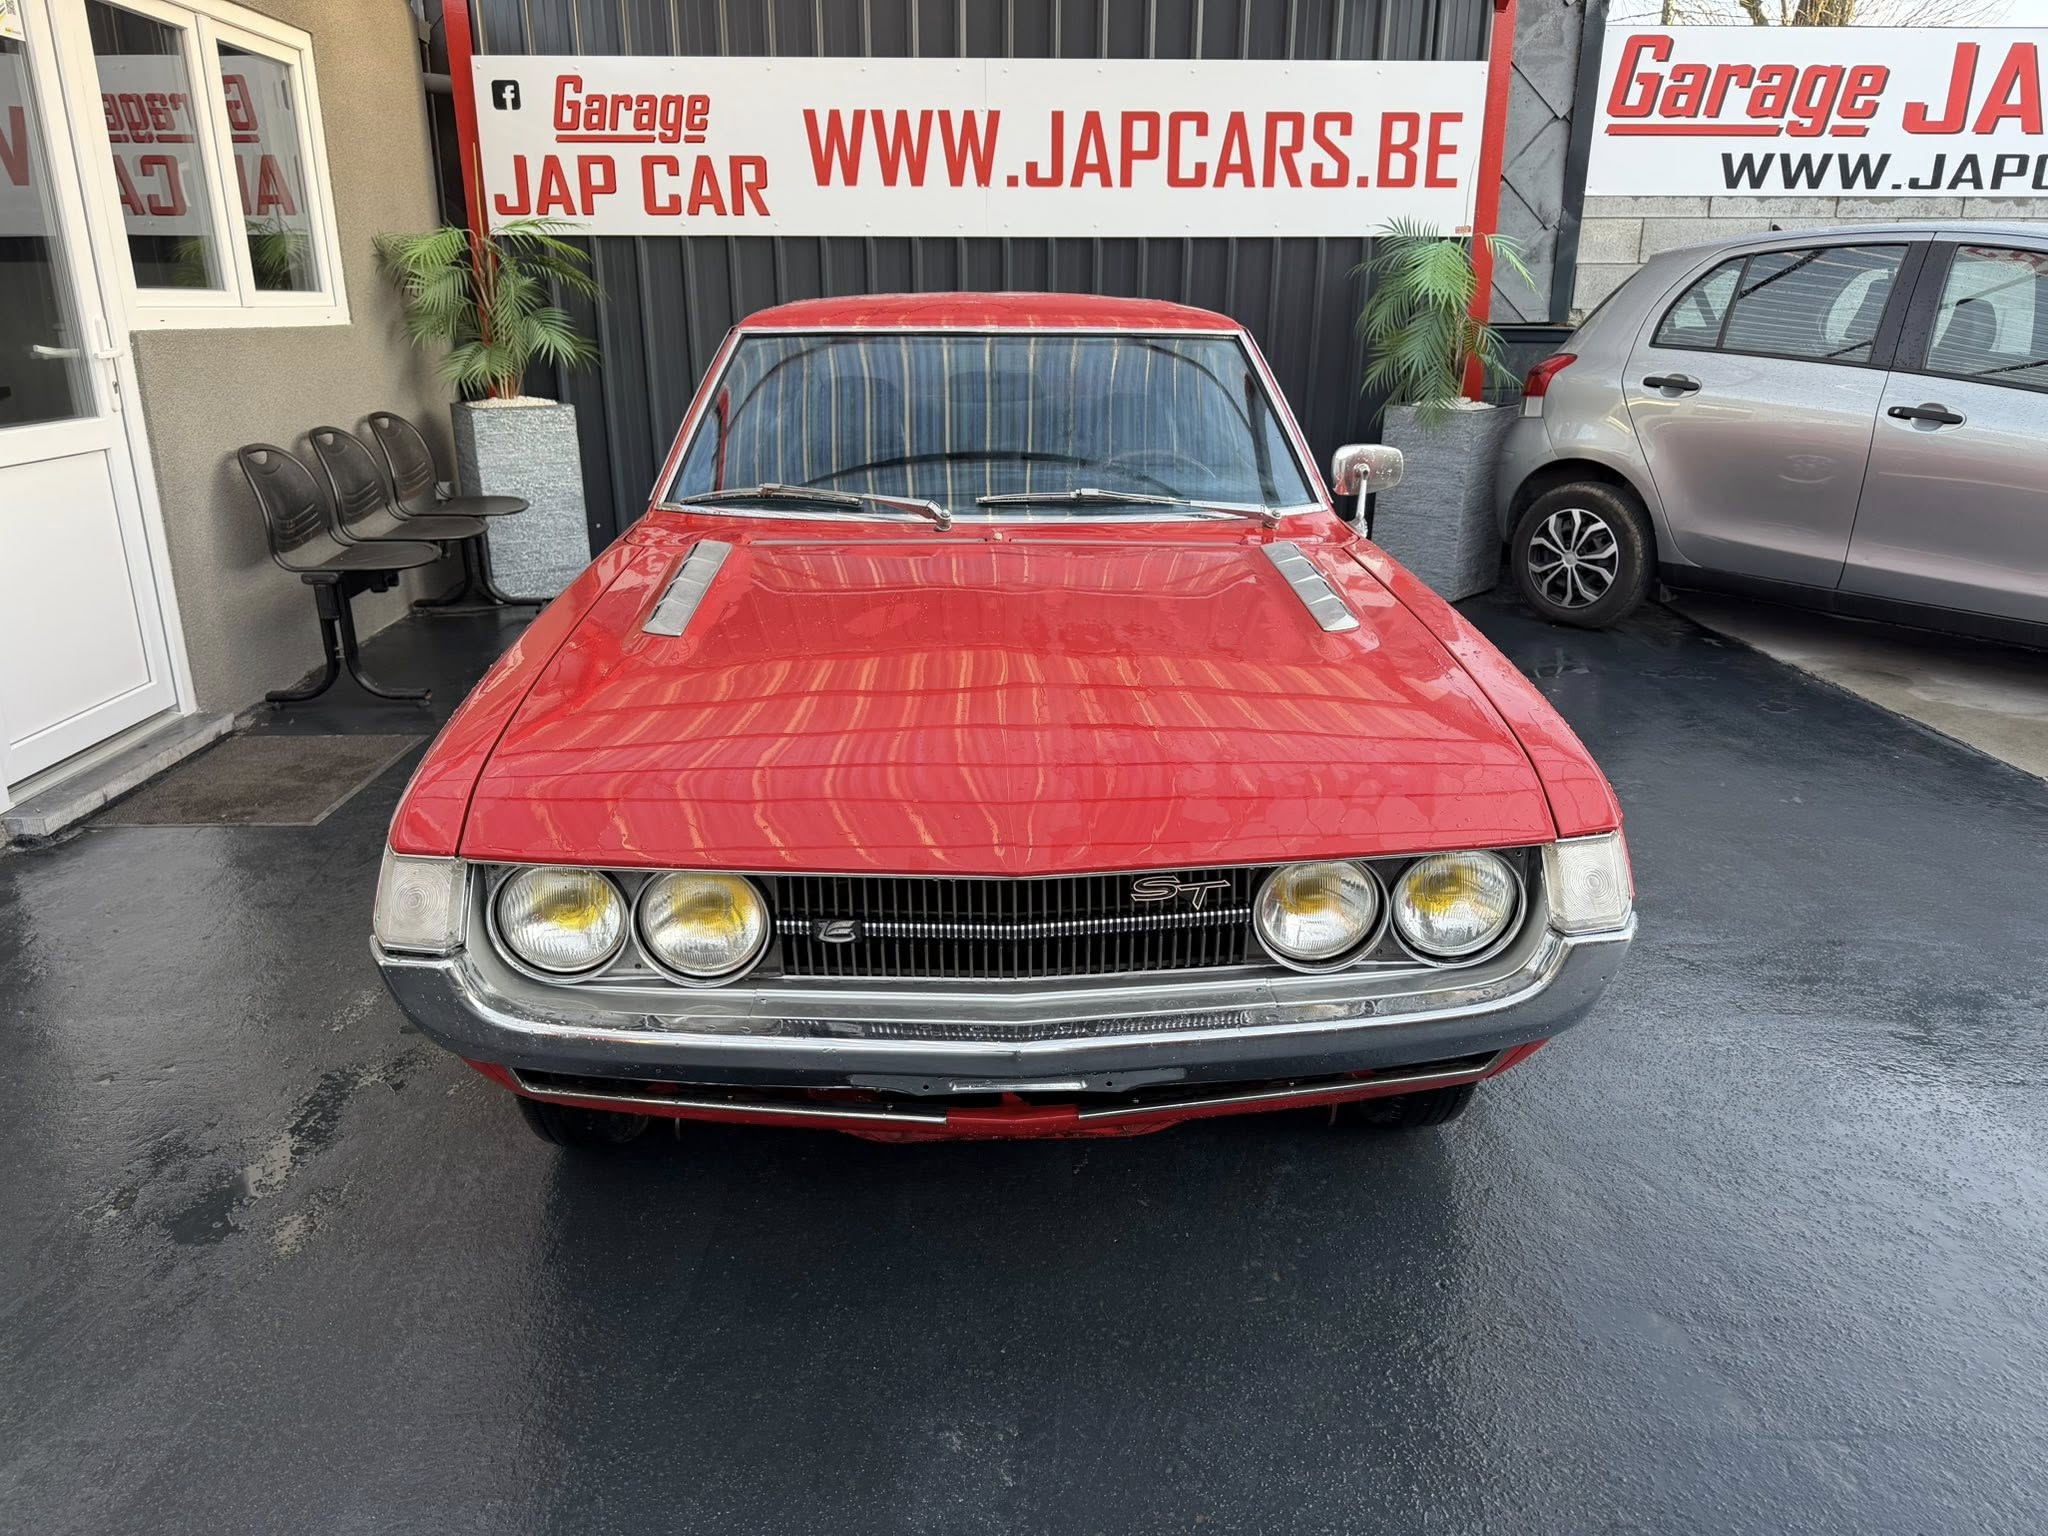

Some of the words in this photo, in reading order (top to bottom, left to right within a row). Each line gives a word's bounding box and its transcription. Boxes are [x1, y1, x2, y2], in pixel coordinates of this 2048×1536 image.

[553, 75, 710, 144] Garage
[1605, 35, 1890, 137] Garage
[803, 109, 1463, 188] WWW.JAPCARS.BE
[494, 155, 616, 216] JAP
[641, 155, 770, 216] CAR
[1131, 875, 1231, 910] ST
